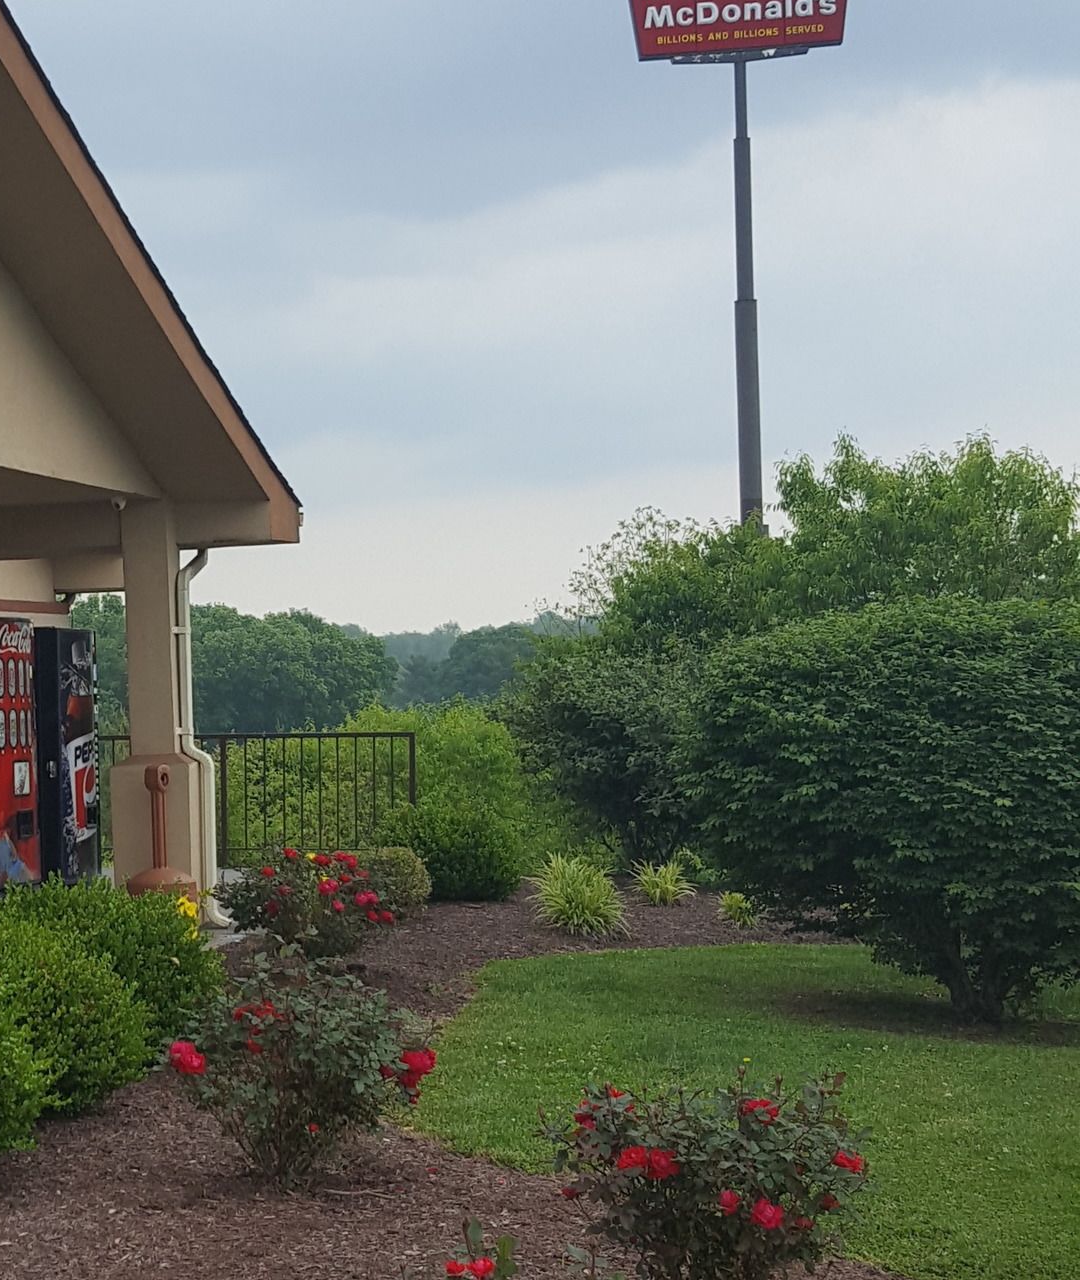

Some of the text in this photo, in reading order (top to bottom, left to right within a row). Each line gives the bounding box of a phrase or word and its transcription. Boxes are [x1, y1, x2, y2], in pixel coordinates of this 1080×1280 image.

[657, 24, 824, 45] BILLIONS AND BILLIONS SERVED
